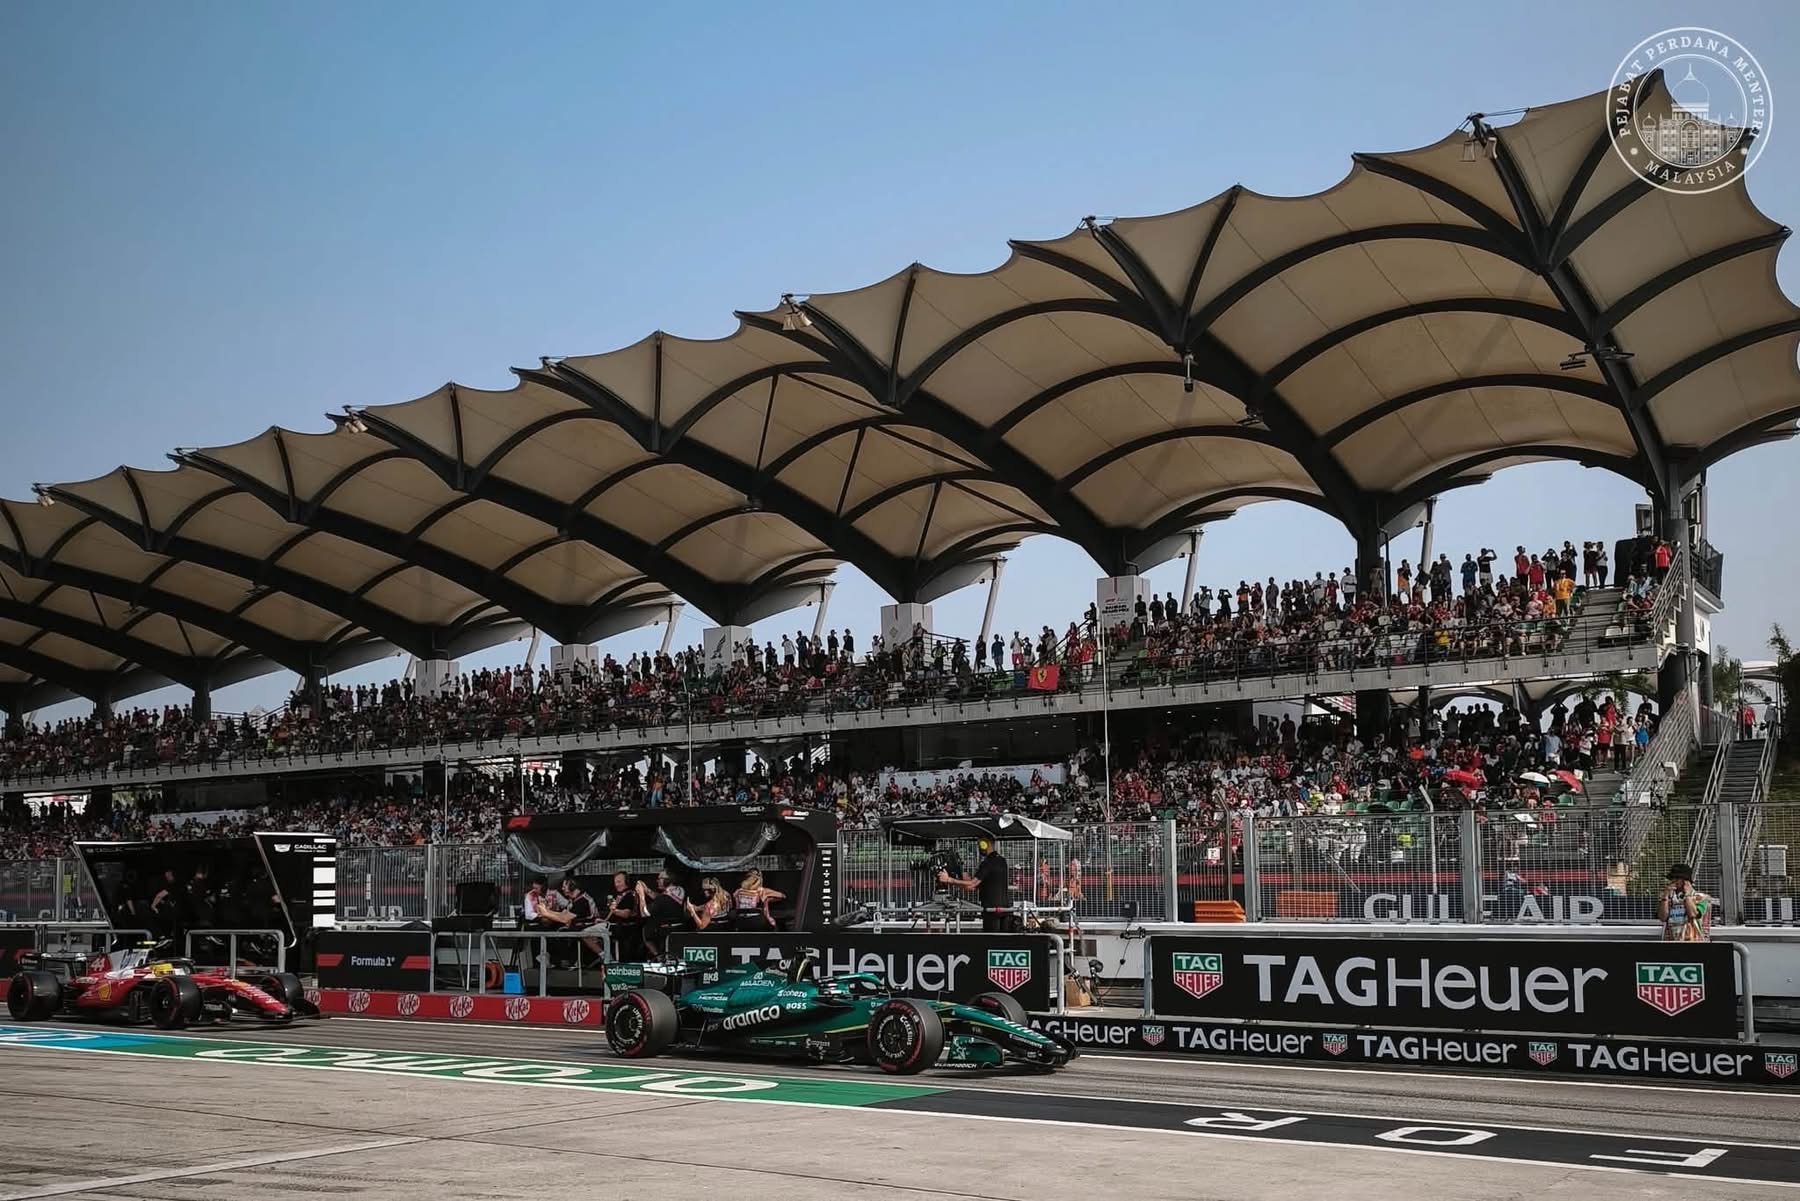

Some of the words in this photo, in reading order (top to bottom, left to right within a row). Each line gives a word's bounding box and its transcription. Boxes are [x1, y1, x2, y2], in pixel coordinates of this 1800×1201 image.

[351, 955, 386, 966] Formula
[685, 949, 715, 962] TAG
[991, 952, 1027, 966] TAG
[1176, 955, 1218, 970] TAG
[607, 966, 641, 976] coinbase
[1641, 965, 1698, 983] TAG
[990, 969, 1029, 991] HEUER
[1176, 973, 1220, 995] HEUER
[1641, 985, 1702, 1013] HEUER
[723, 1005, 780, 1031] aramco
[1030, 1019, 1136, 1045] GHeuer
[1325, 1034, 1346, 1042] TAG
[1531, 1043, 1555, 1051] TAG
[1767, 1054, 1794, 1063] TAG
